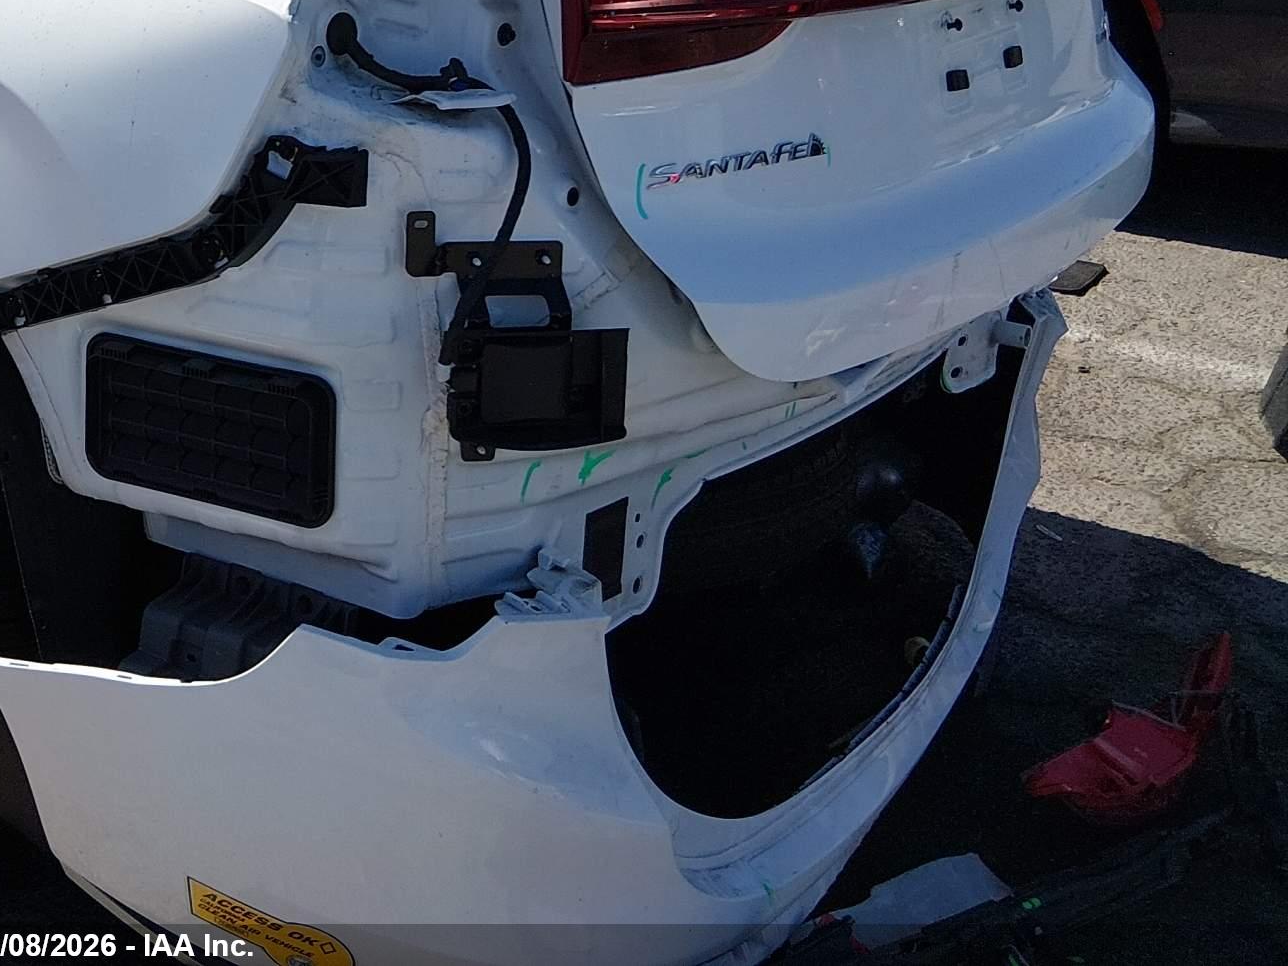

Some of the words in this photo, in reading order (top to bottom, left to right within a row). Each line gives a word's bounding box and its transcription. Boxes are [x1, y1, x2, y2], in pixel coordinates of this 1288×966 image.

[198, 903, 238, 929] CLEAN
[240, 924, 262, 936] AIR
[265, 934, 316, 958] VEHICLE
[203, 893, 284, 932] ACCESS
[287, 931, 320, 947] OK
